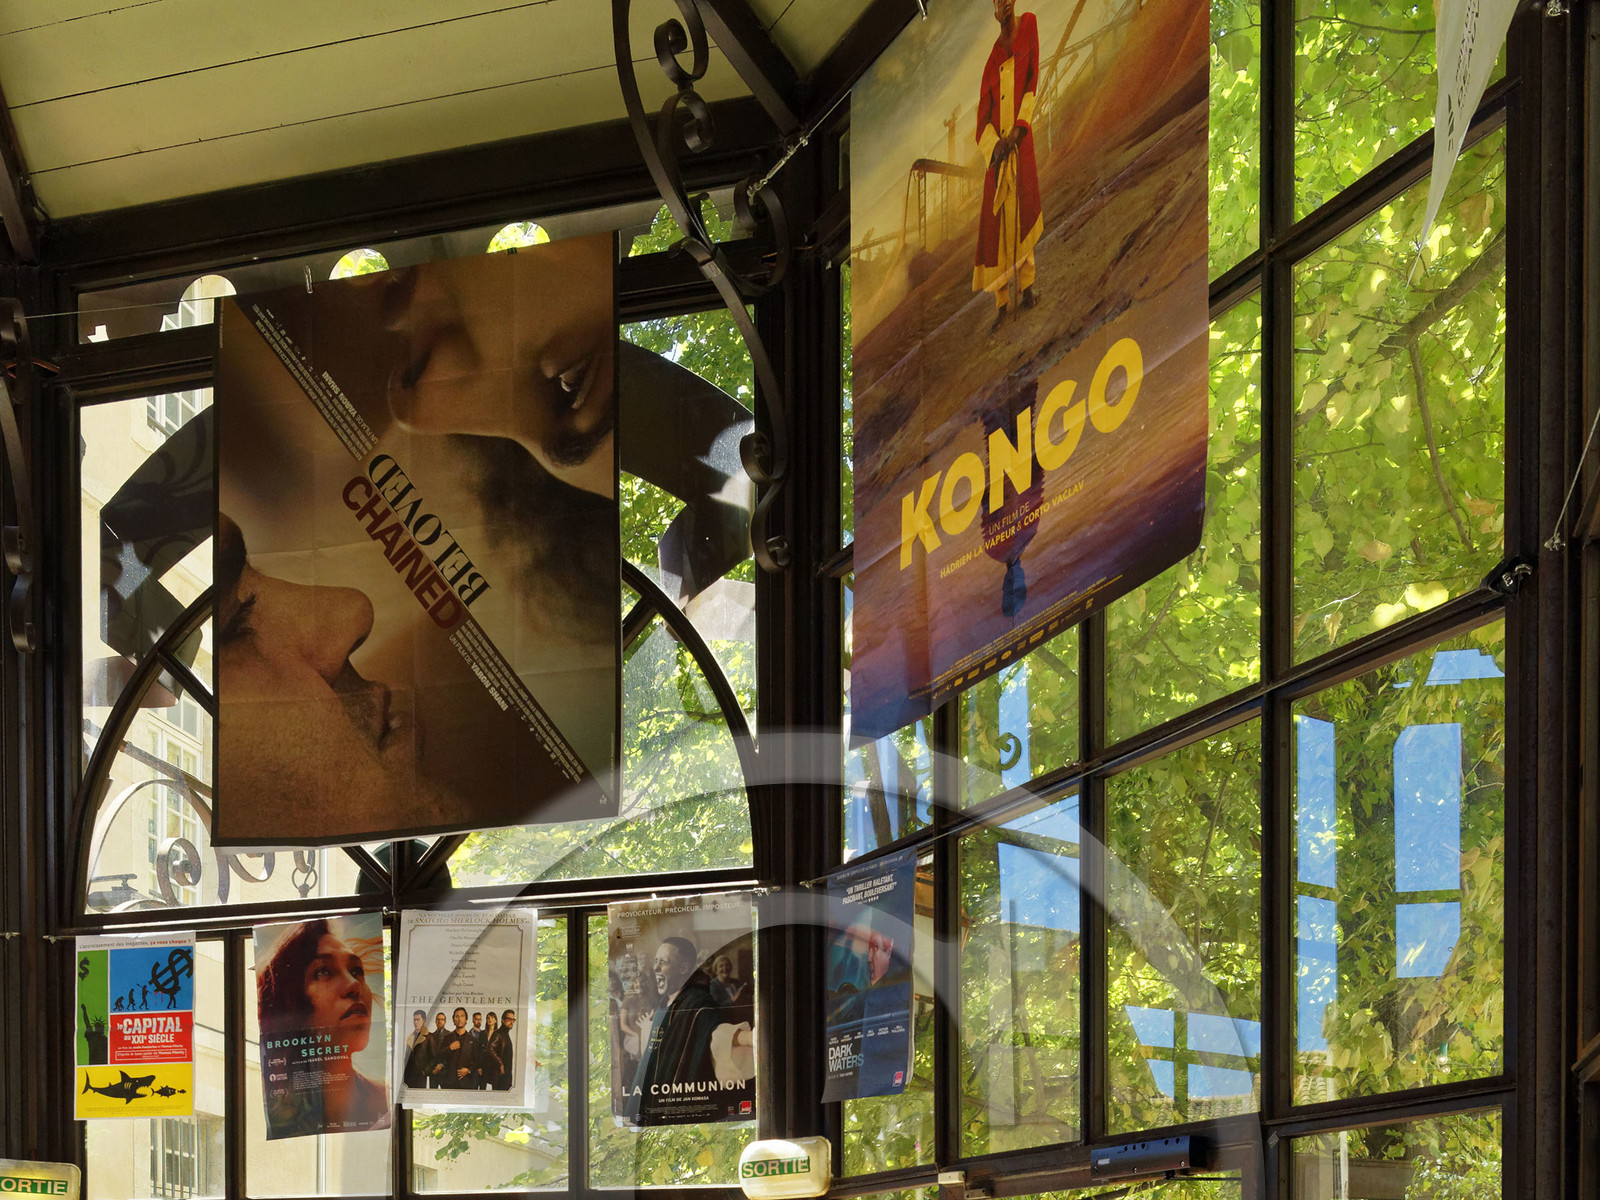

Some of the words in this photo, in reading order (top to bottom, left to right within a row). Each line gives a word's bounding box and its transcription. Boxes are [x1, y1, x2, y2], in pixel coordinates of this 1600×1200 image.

[321, 370, 341, 395] SHANI
[338, 392, 358, 417] YARON
[354, 414, 364, 424] DE
[360, 421, 373, 436] FILM
[369, 434, 379, 444] UN
[900, 338, 1143, 571] KONGO
[989, 520, 1001, 536] UN
[1002, 511, 1018, 530] FILM
[1019, 502, 1030, 518] DE
[368, 454, 491, 609] BELOVED
[940, 552, 973, 579] HADRIEN
[973, 545, 983, 559] LA
[984, 525, 1016, 554] VAPEUR
[1017, 522, 1022, 533] &
[1023, 502, 1050, 528] CORTO
[1052, 480, 1085, 511] VACLAV
[342, 475, 463, 630] CHAINED
[448, 634, 458, 646] UN
[454, 643, 467, 656] FILM
[462, 653, 473, 665] DE
[470, 662, 492, 689] YARON
[488, 686, 509, 712] SHANI
[854, 880, 873, 892] THRILLER
[618, 908, 663, 918] PROVOCATEUR.
[665, 905, 701, 913] PRÊCHEUR.
[703, 902, 742, 910] IMPOSTEUR.
[440, 996, 512, 1004] GENTLEMEN
[123, 1017, 182, 1034] CAPITAL
[148, 1033, 174, 1043] SIÈCLE
[267, 1035, 331, 1049] BROOKLYN
[301, 1045, 349, 1057] SECRET
[829, 1043, 853, 1060] DARK
[829, 1053, 864, 1073] WATERS
[622, 1085, 643, 1097] LA
[650, 1079, 746, 1095] COMMUNION
[743, 1157, 808, 1177] SORTIE
[0, 1178, 66, 1194] ORTIE
